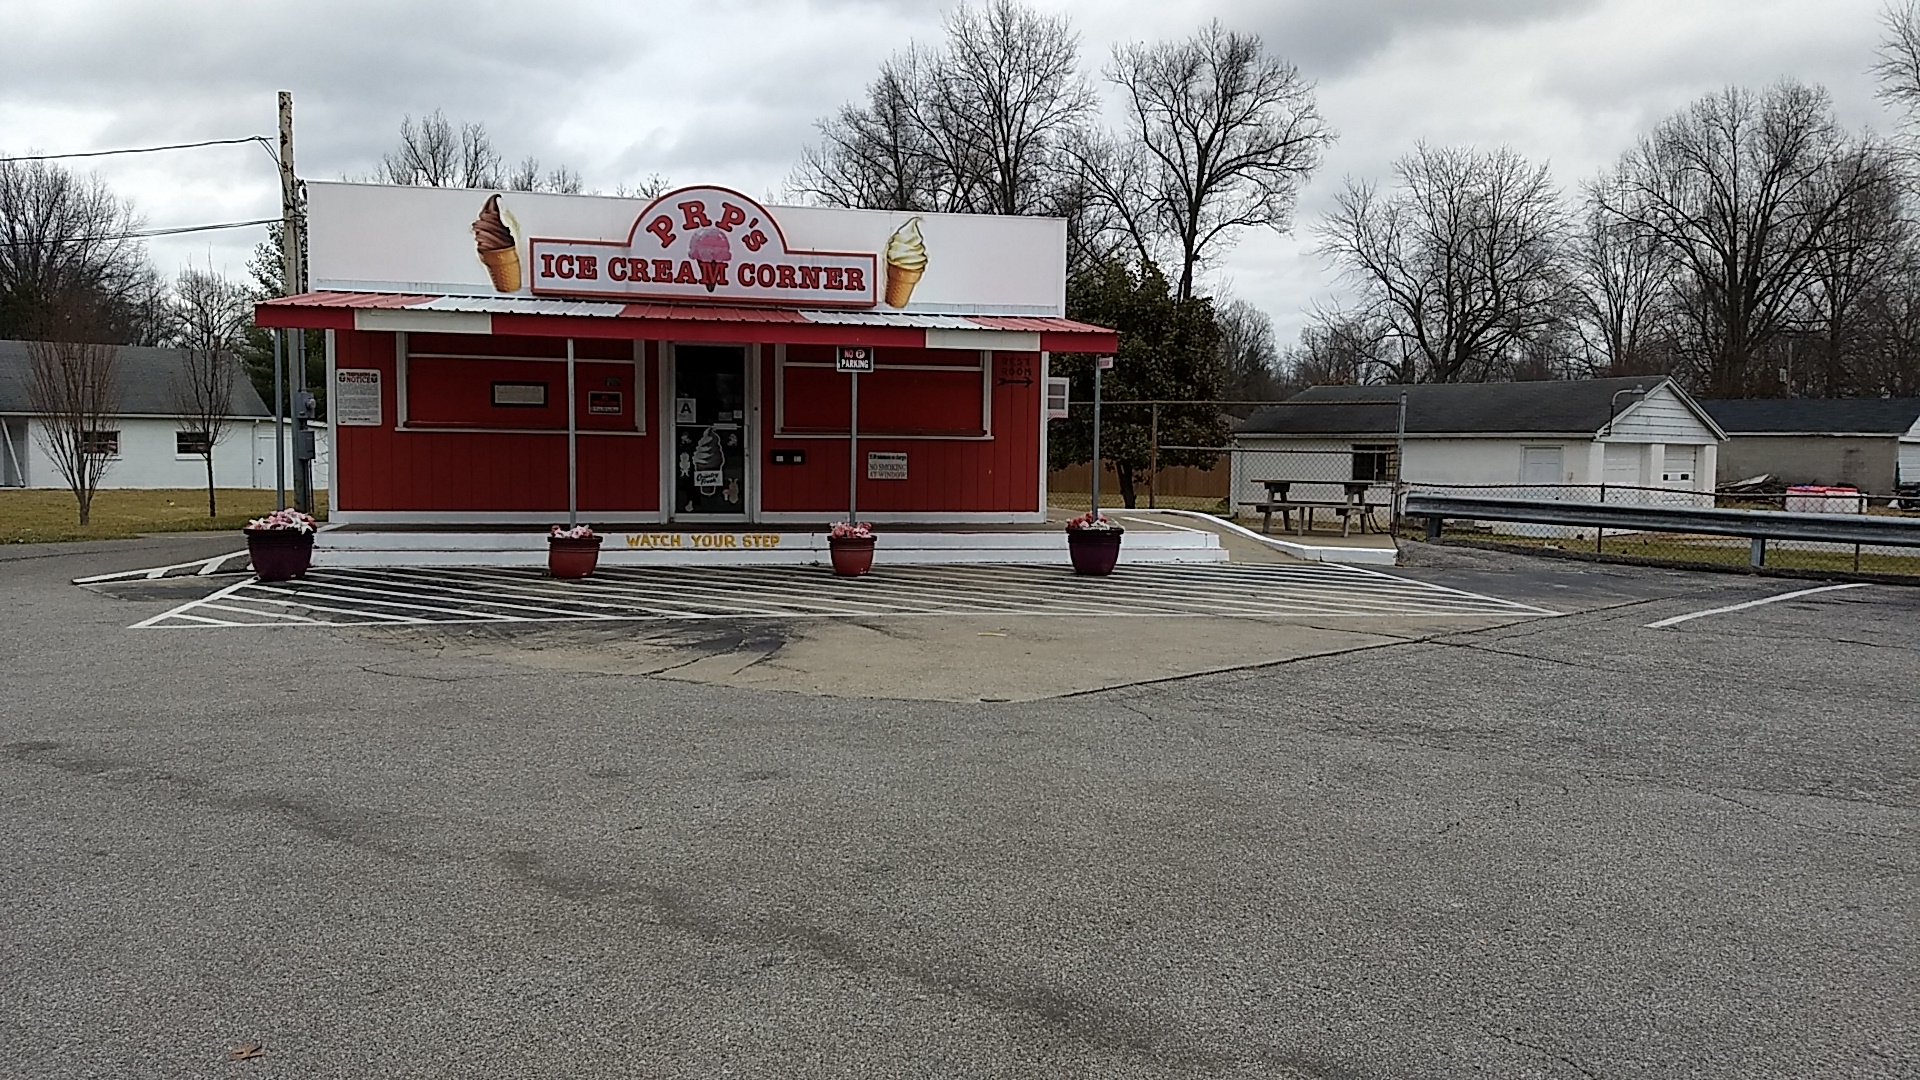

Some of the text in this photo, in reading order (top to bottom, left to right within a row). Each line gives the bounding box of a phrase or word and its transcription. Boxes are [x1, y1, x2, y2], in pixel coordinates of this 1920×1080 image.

[540, 254, 866, 291] ICE CREAM CORNER
[844, 350, 853, 358] NO
[841, 359, 869, 368] PARKING
[1002, 357, 1030, 366] REST
[1002, 367, 1032, 376] ROOM
[681, 403, 692, 414] A
[626, 534, 780, 548] WATCH YOUR STEP
